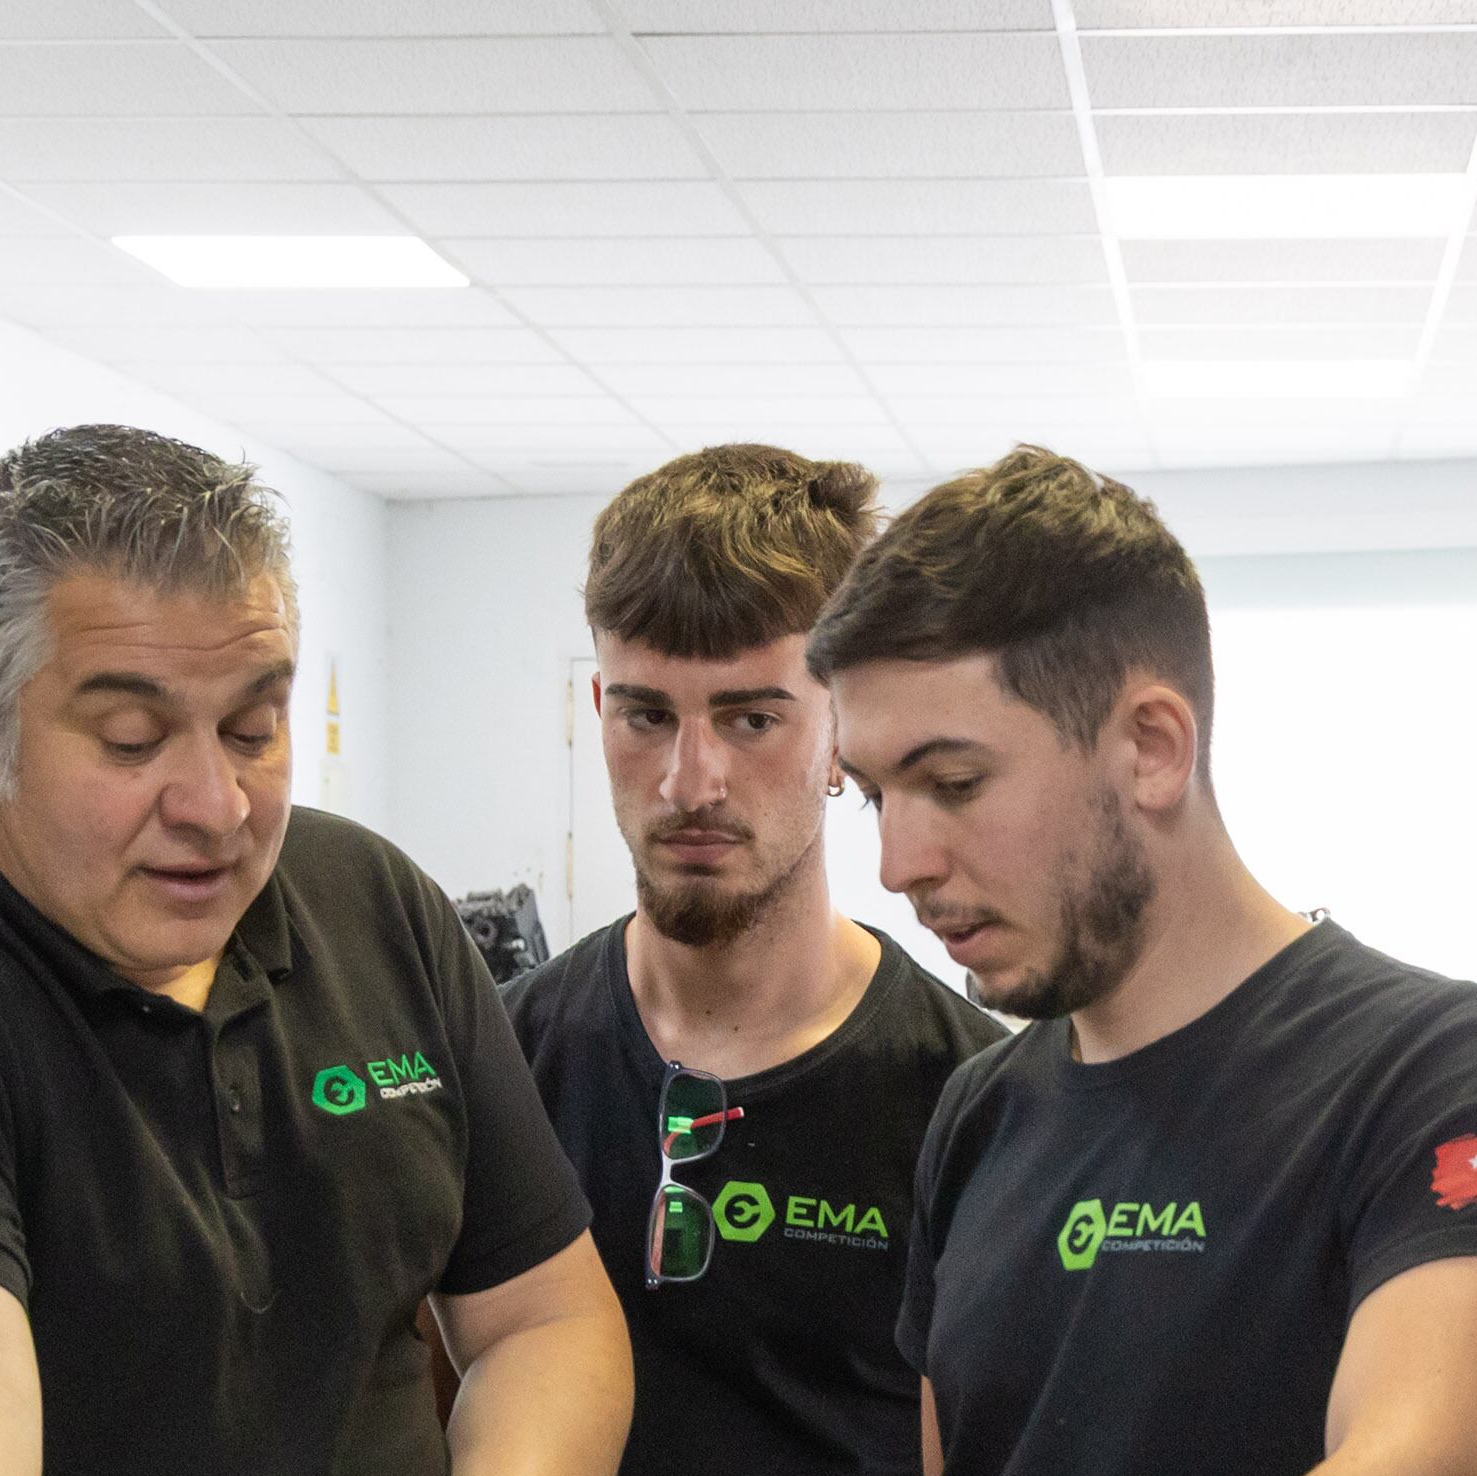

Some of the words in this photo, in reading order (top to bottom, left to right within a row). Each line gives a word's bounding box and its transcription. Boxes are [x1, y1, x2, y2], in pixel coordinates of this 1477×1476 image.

[367, 1050, 438, 1087] EMA
[786, 1195, 889, 1239] EMA
[1106, 1201, 1207, 1238] EMA
[784, 1228, 889, 1250] COMPETICIÓN
[1101, 1237, 1206, 1252] COMPETICIÓN
